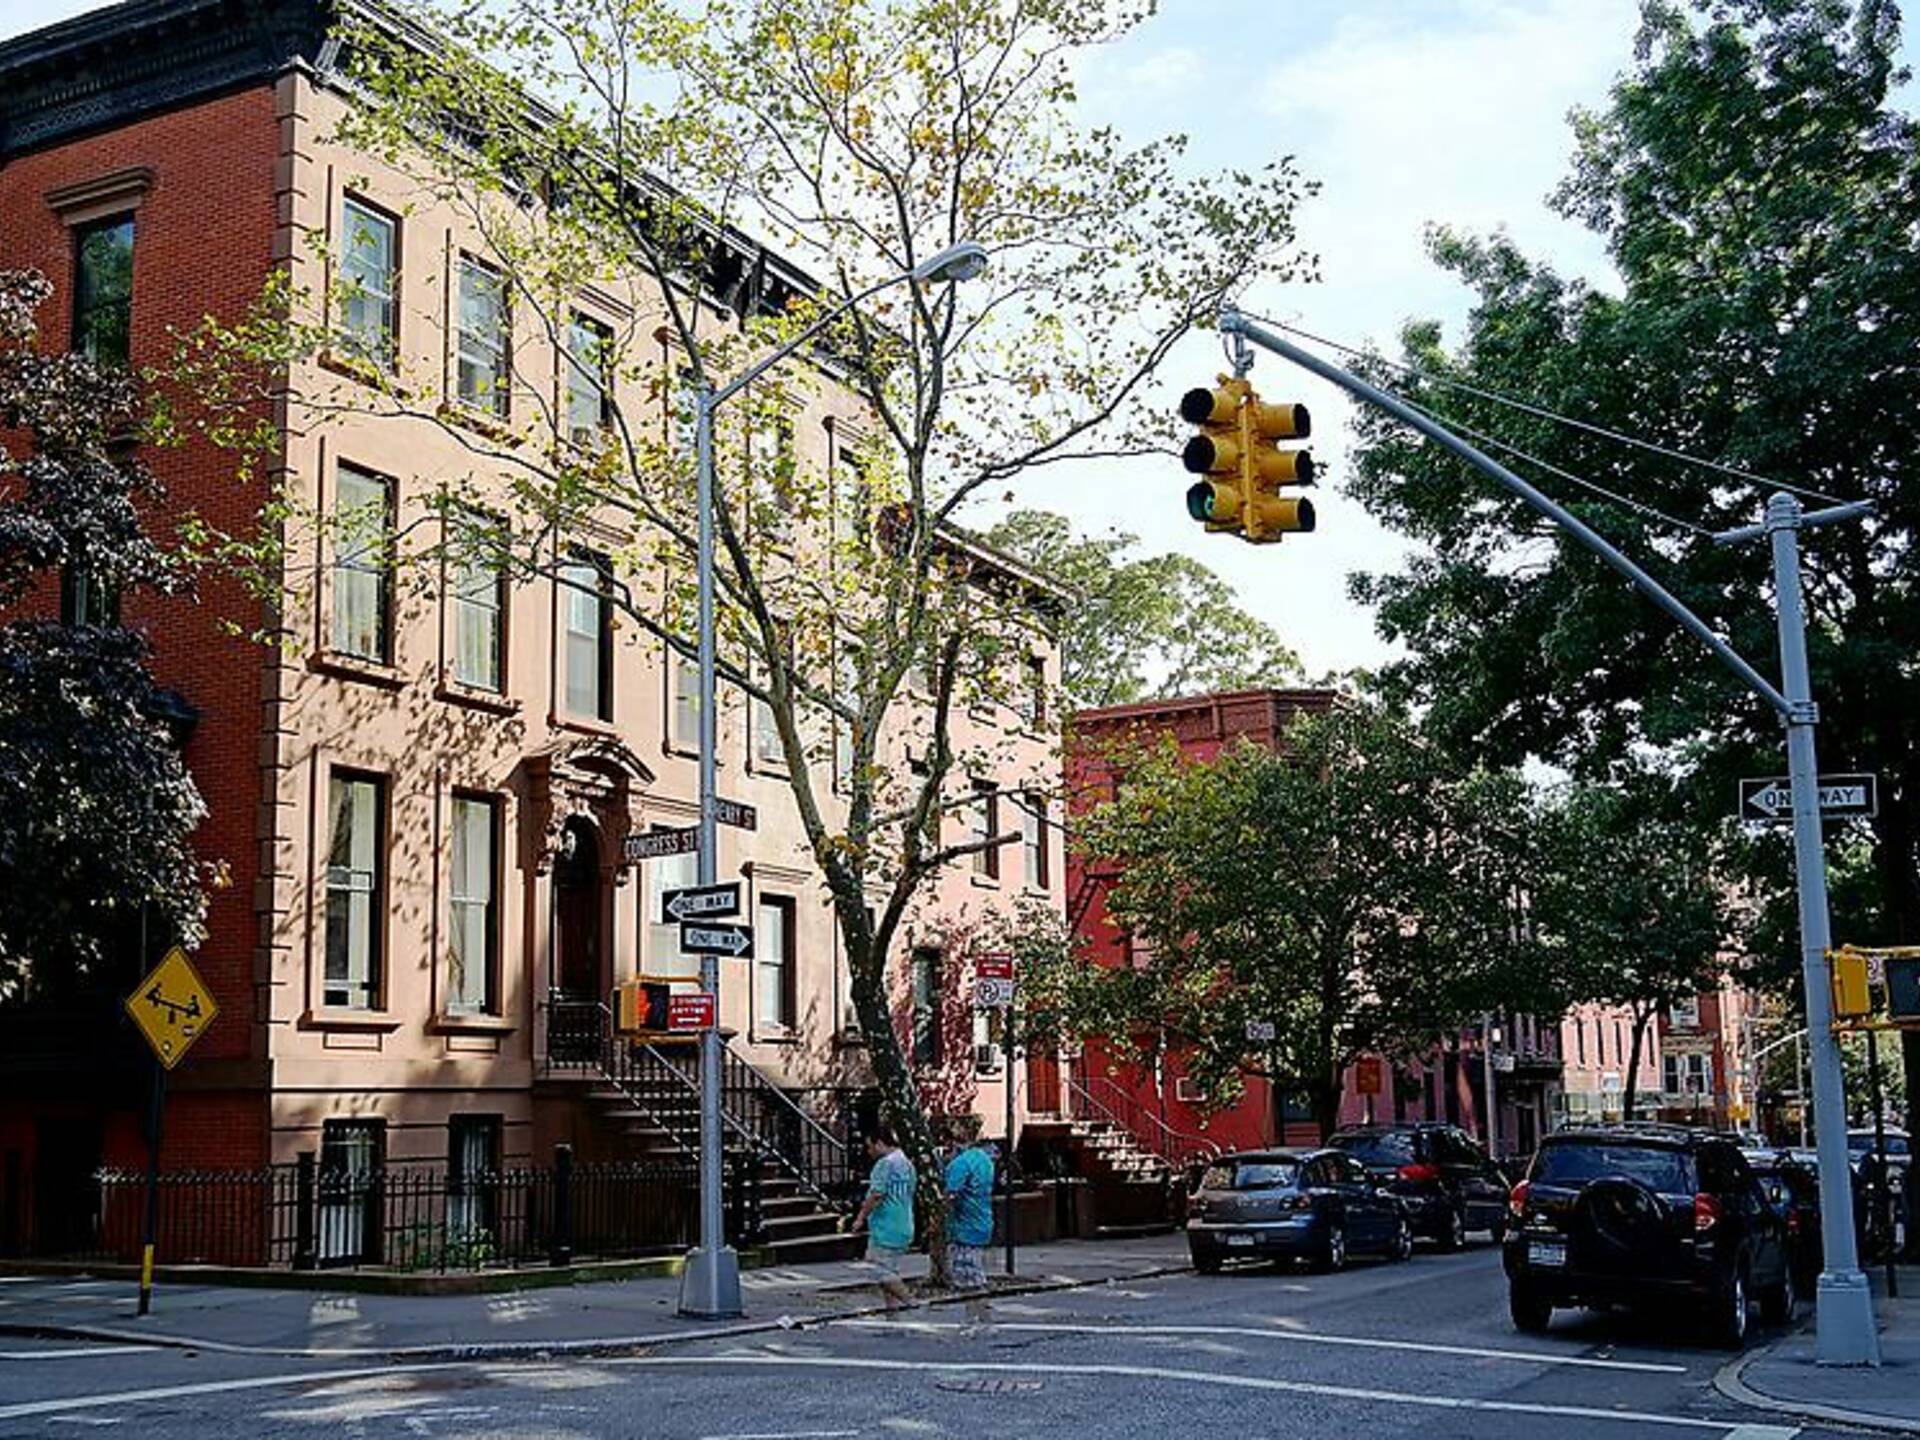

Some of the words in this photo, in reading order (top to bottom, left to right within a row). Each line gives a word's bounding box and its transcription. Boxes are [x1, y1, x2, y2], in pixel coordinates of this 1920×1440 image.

[1764, 790, 1792, 808] ON
[624, 832, 679, 859] CONGRESS
[681, 829, 695, 851] ST
[671, 897, 694, 913] ONE
[705, 894, 730, 909] WAY
[690, 929, 712, 945] ONE
